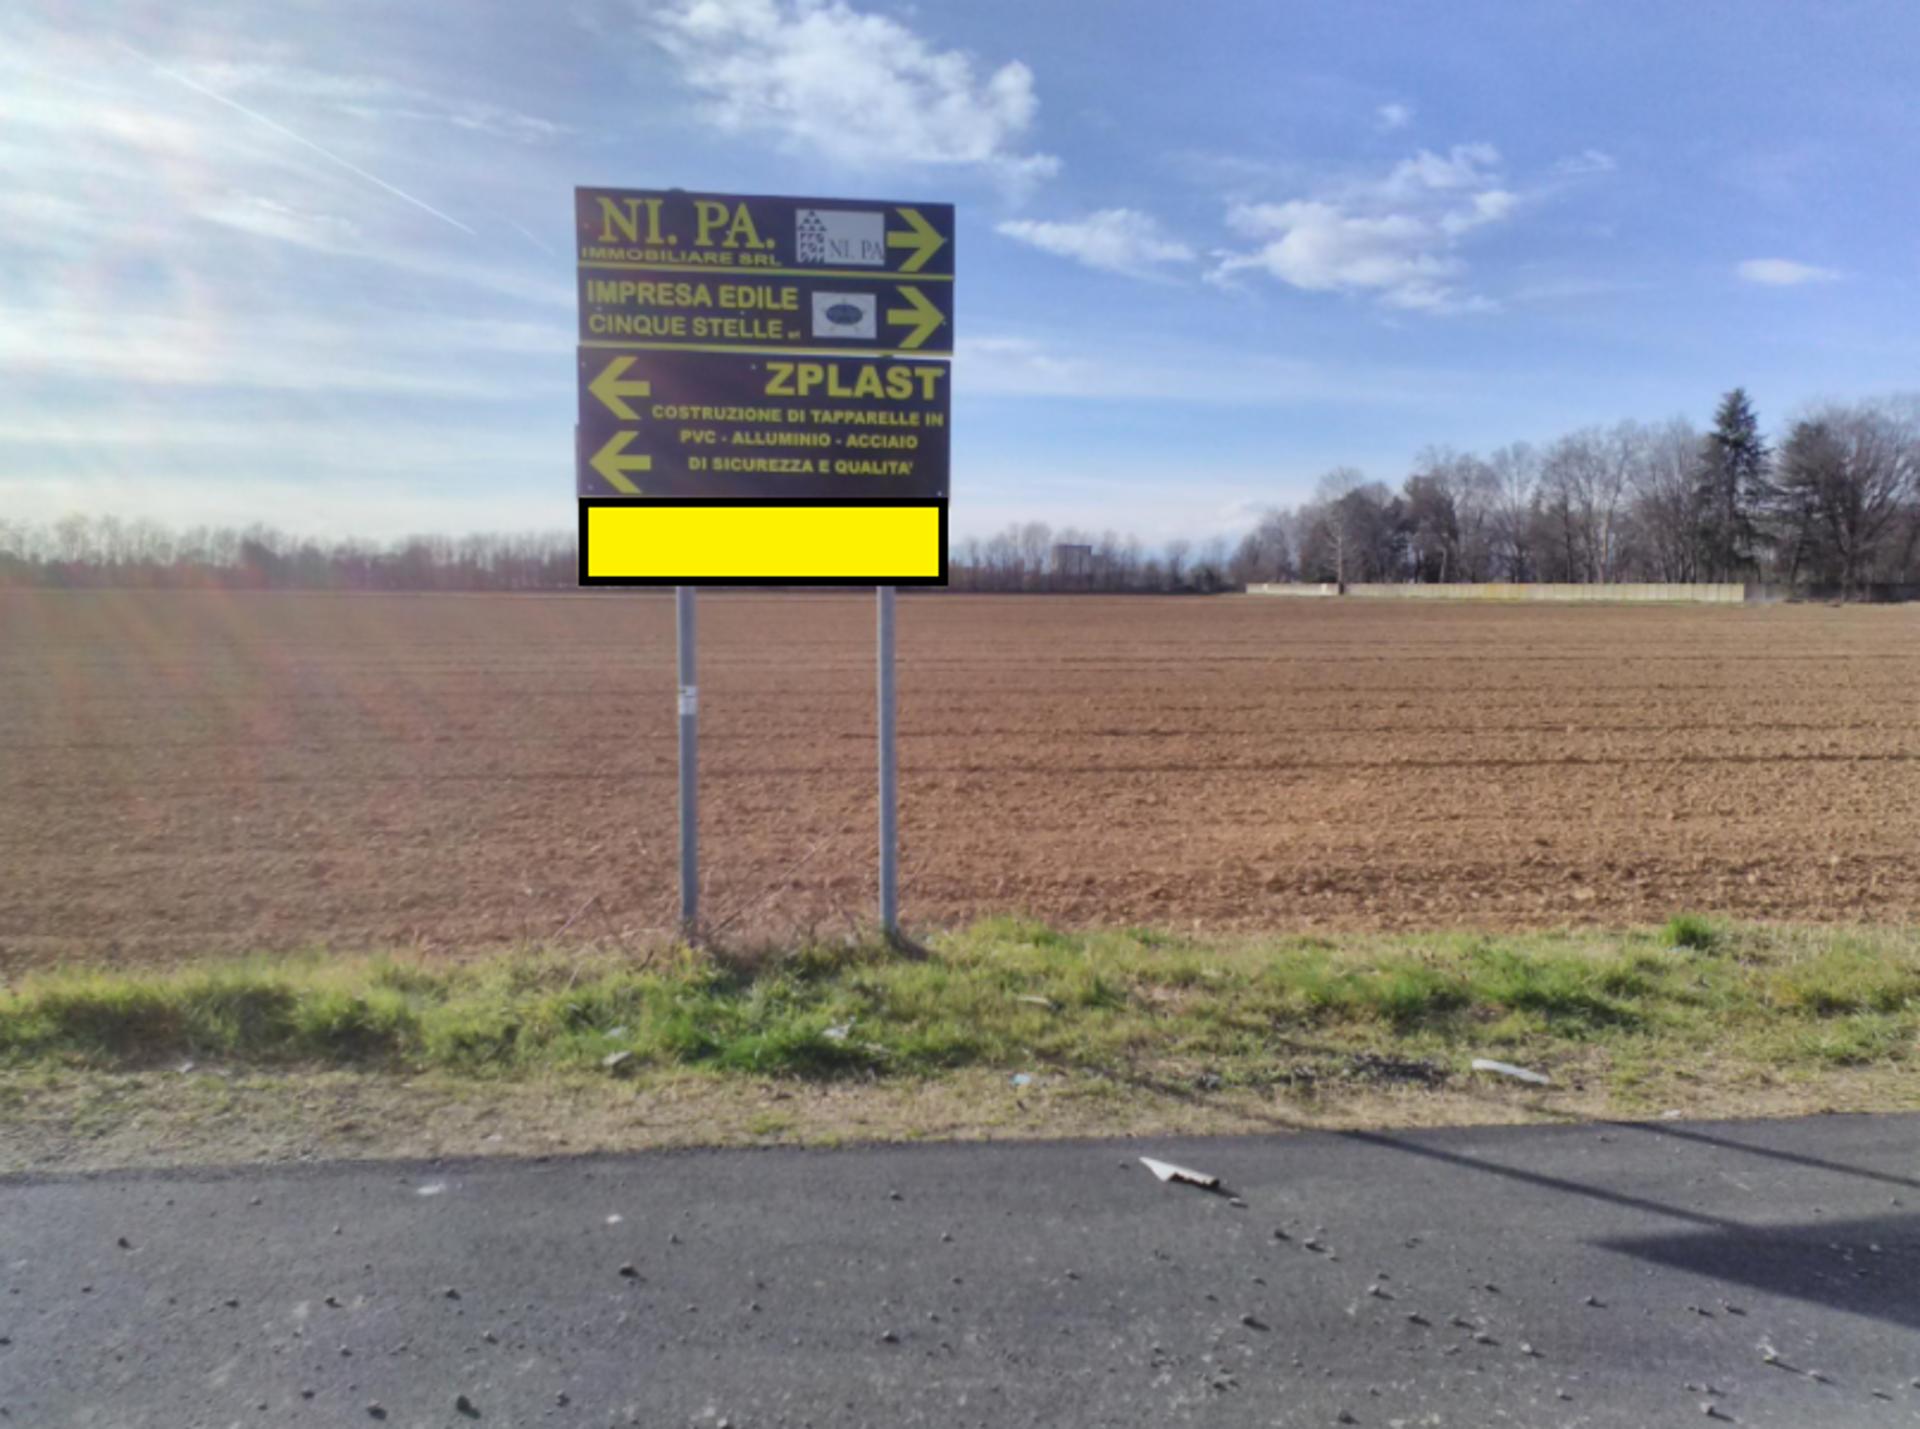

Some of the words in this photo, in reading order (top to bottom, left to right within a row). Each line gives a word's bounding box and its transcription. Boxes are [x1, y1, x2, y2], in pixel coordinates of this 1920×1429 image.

[598, 196, 678, 246] NI.
[694, 200, 776, 250] PA.
[581, 246, 733, 264] IMMOBILIARE
[586, 279, 712, 308] IMPRESA
[718, 283, 799, 311] EDILE
[588, 313, 687, 337] CINQUE
[692, 314, 782, 340] STELLE
[764, 361, 945, 401] ZPLAST
[651, 404, 782, 424] COSTRUZIONE
[786, 408, 806, 424] DI
[812, 408, 919, 426] TAPPARELLE
[924, 411, 944, 427] IN
[680, 430, 716, 446] PVC
[732, 431, 831, 448] ALLUMINIO
[845, 433, 918, 449] ACCIAIO
[687, 457, 708, 472] DI
[711, 457, 814, 474] SICUREZZA
[818, 459, 830, 473] E
